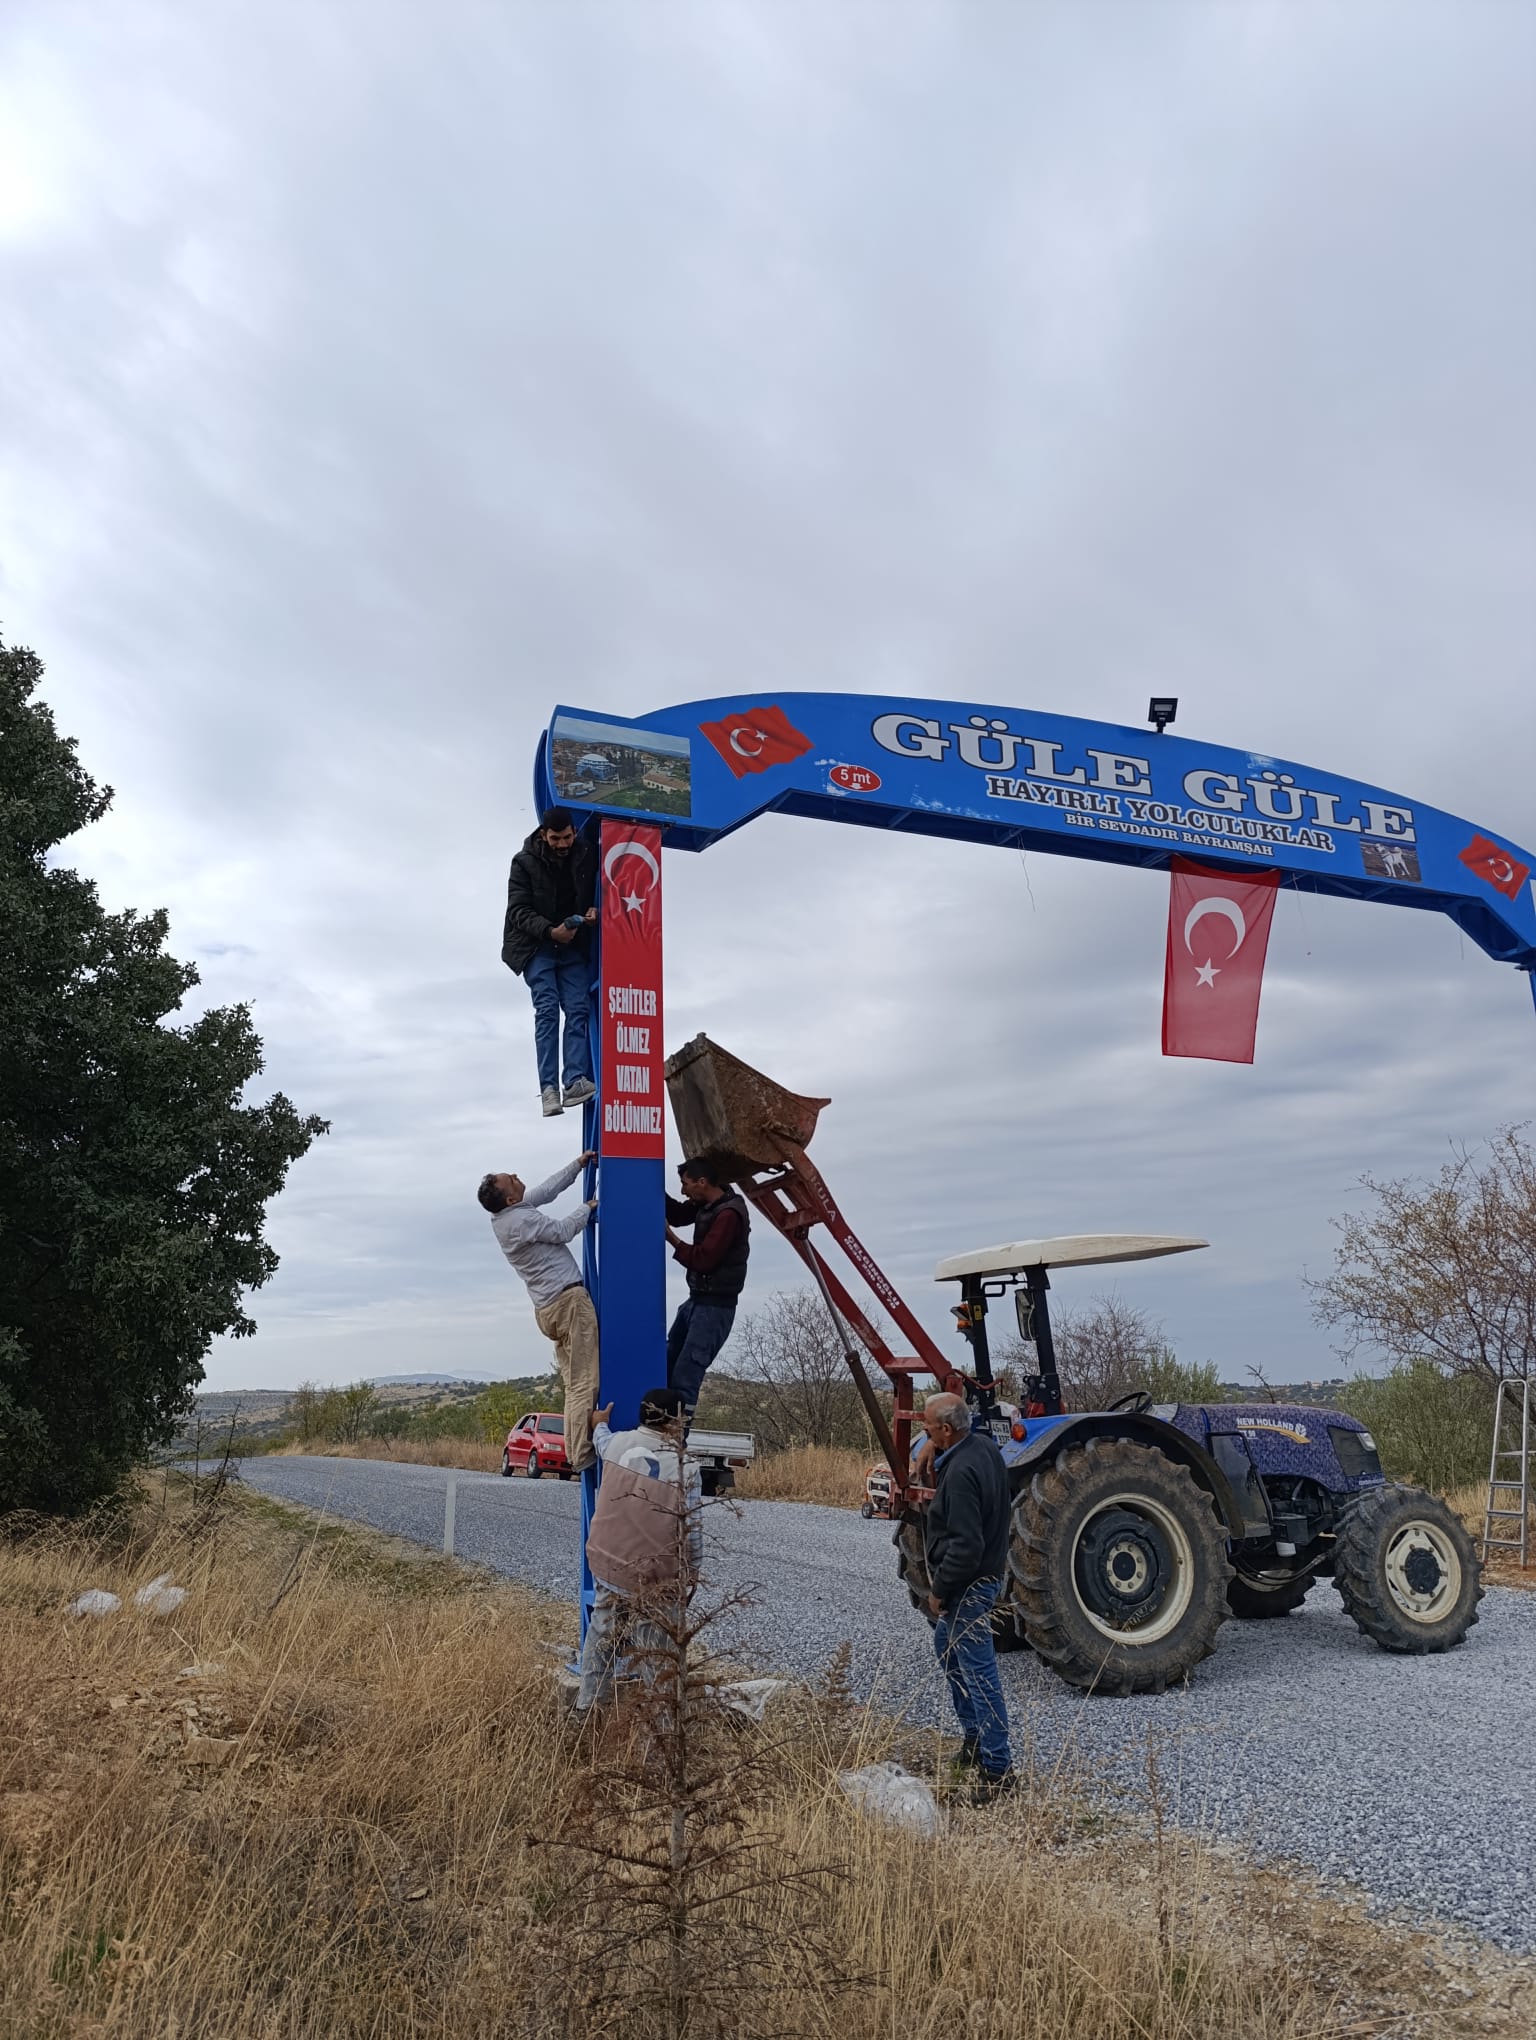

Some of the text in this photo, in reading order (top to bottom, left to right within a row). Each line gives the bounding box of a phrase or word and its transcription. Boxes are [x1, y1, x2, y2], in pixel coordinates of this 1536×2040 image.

[840, 768, 871, 785] 5 mt
[871, 713, 1416, 843] GÜLE GÜLE
[986, 775, 1334, 852] HAYIRLI YOLCULUKLAR
[1064, 812, 1274, 857] BİR SEVDADIR BAYRAMŞAH
[608, 984, 657, 1018] ŞEHİTLER
[616, 1021, 650, 1054] ÖLMEZ
[616, 1065, 650, 1094] VATAN
[605, 1100, 662, 1134] BÖLÜNMEZ
[1236, 1417, 1294, 1431] NEW HOLLAND
